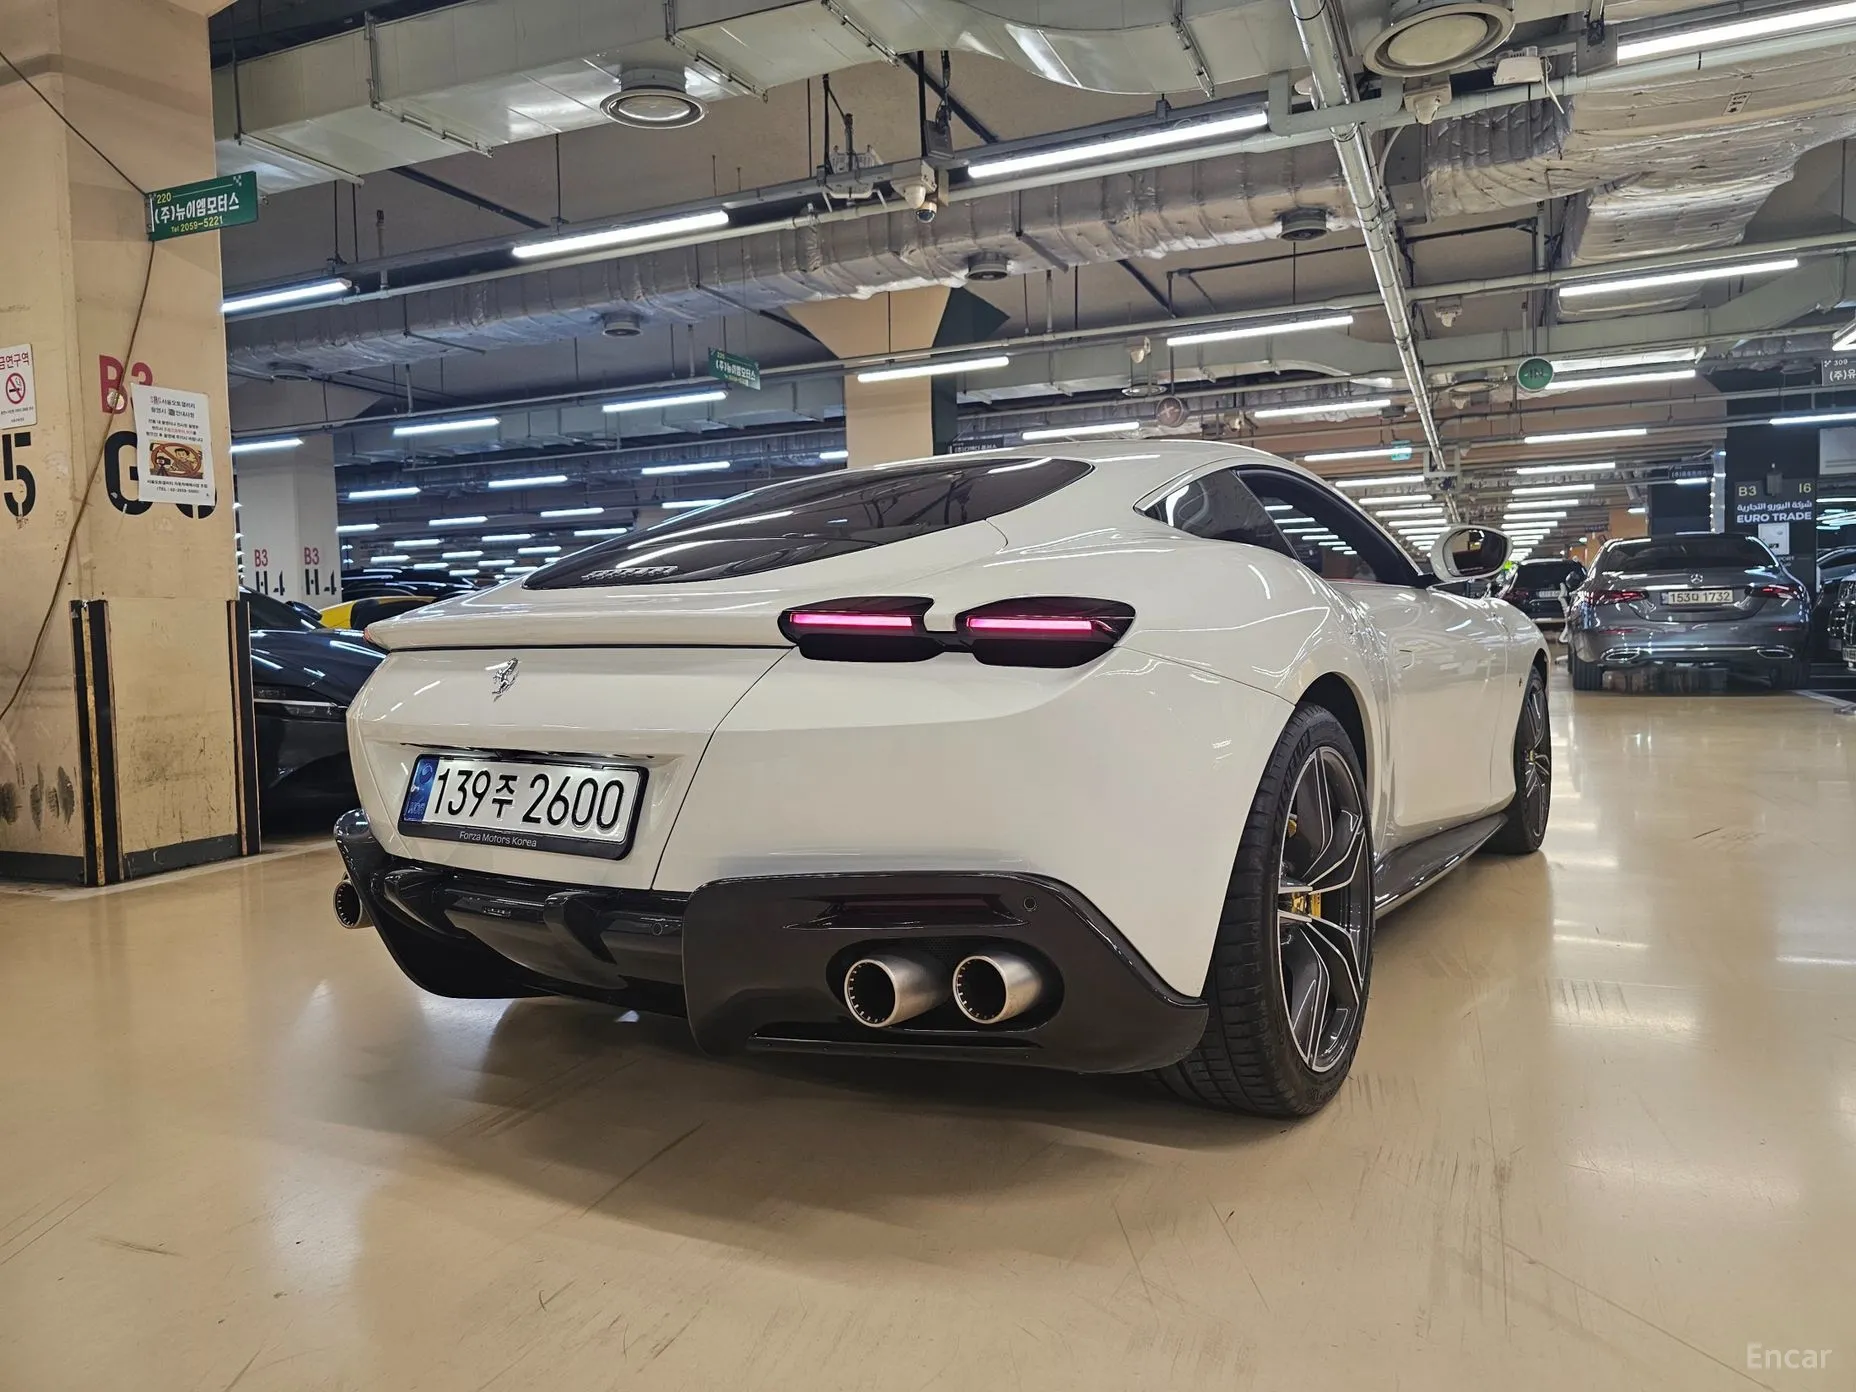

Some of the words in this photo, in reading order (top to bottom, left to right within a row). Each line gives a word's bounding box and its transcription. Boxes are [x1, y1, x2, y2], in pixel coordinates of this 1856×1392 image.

[156, 192, 172, 204] 220
[180, 215, 224, 232] 2059-5221
[1, 431, 36, 519] 5
[1738, 485, 1757, 497] B3
[1736, 513, 1770, 523] EURO
[1772, 511, 1812, 521] TRADE
[254, 549, 269, 567] B3
[304, 547, 320, 565] B3
[434, 767, 518, 819] 139주
[522, 773, 625, 829] 2600
[459, 831, 480, 841] Forza
[481, 833, 511, 845] Motors
[511, 836, 537, 847] Korea
